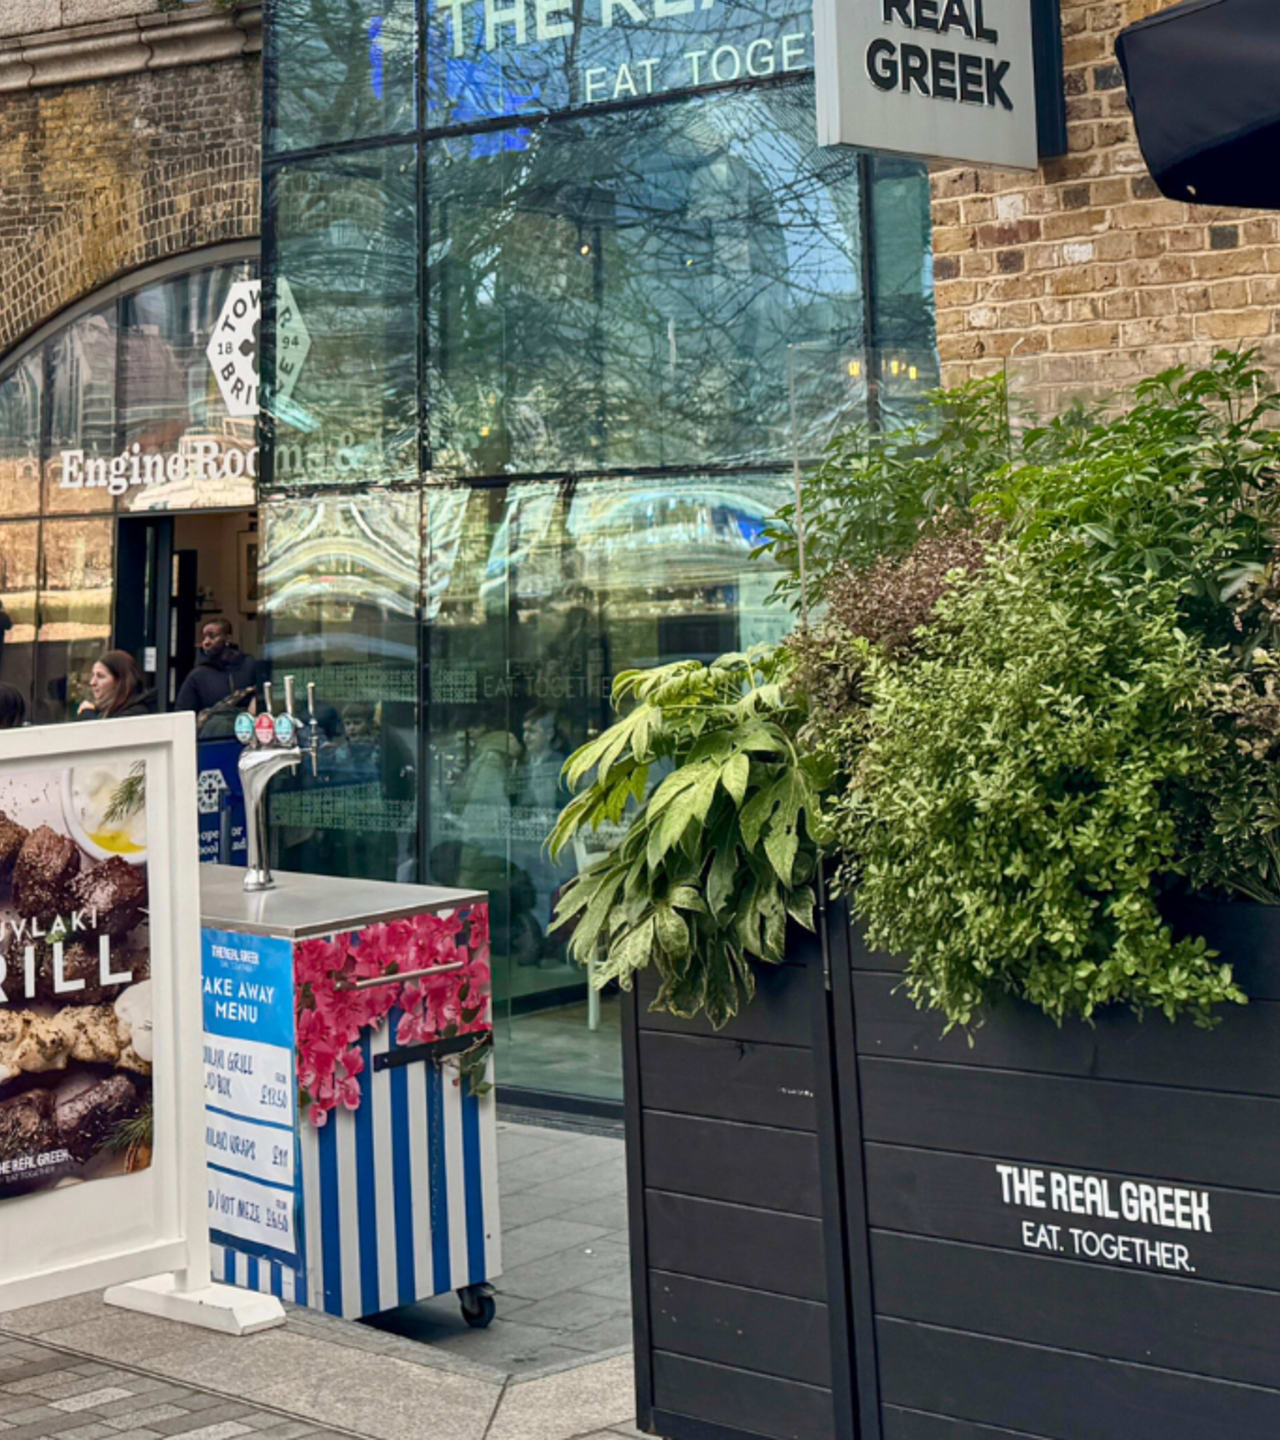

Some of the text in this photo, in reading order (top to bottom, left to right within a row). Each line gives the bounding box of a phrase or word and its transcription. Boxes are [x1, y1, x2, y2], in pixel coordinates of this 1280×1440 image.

[684, 30, 816, 87] TOGE
[865, 37, 1013, 111] GREEK
[217, 341, 233, 355] 18
[59, 442, 188, 495] Engine
[525, 674, 612, 700] TOGETHE
[215, 1000, 258, 1024] MENU
[238, 981, 275, 1004] AWAY
[996, 1164, 1212, 1233] THE REAL GREEK
[1022, 1220, 1196, 1272] EAT. TOGETHER.
